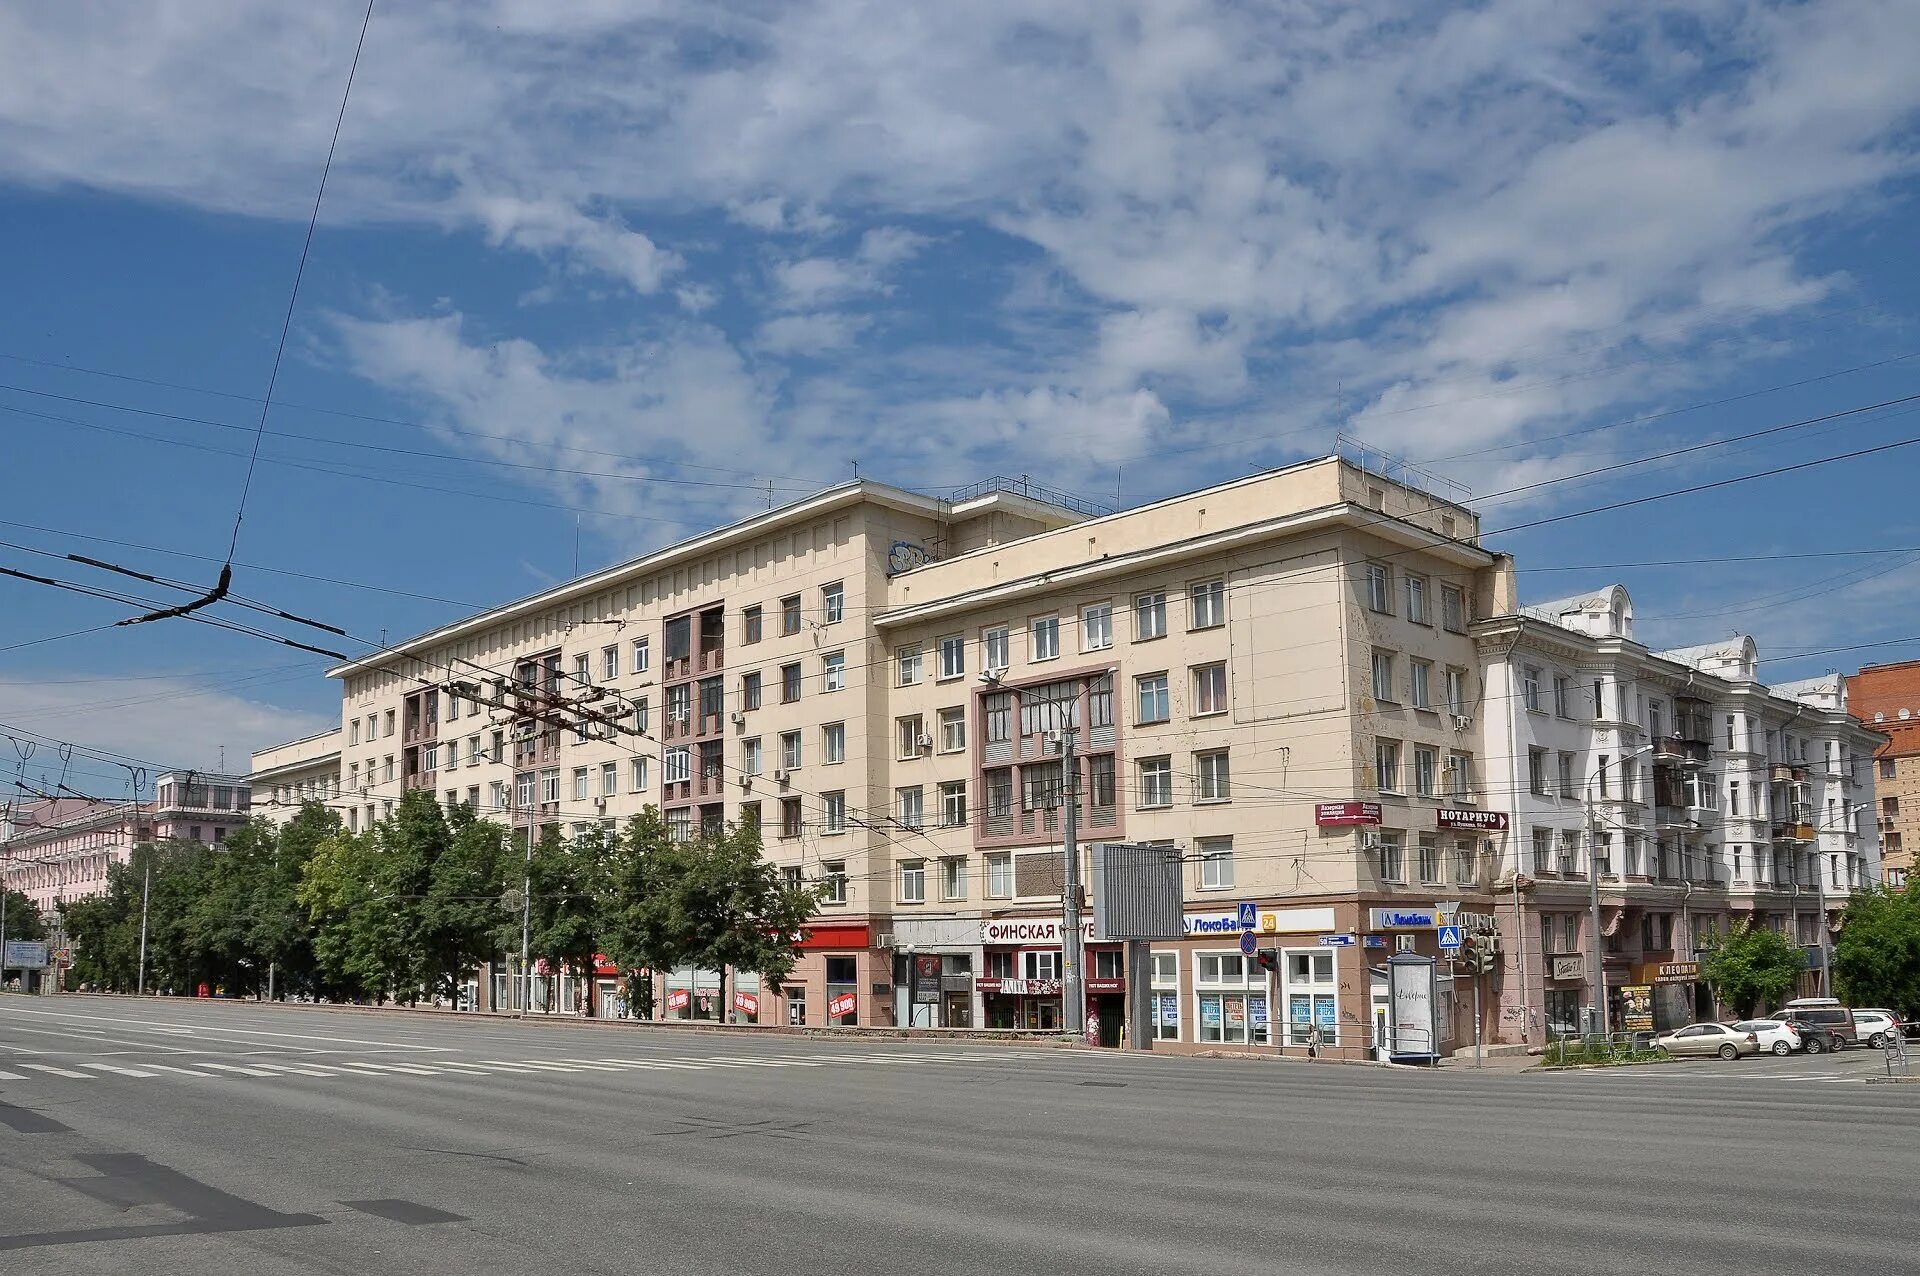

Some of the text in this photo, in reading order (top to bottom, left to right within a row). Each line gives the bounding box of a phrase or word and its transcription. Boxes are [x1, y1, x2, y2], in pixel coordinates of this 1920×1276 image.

[1440, 810, 1496, 823] НОТАРИУС
[989, 924, 1055, 940] ФИНСКАЯ
[1000, 980, 1028, 994] JANITA
